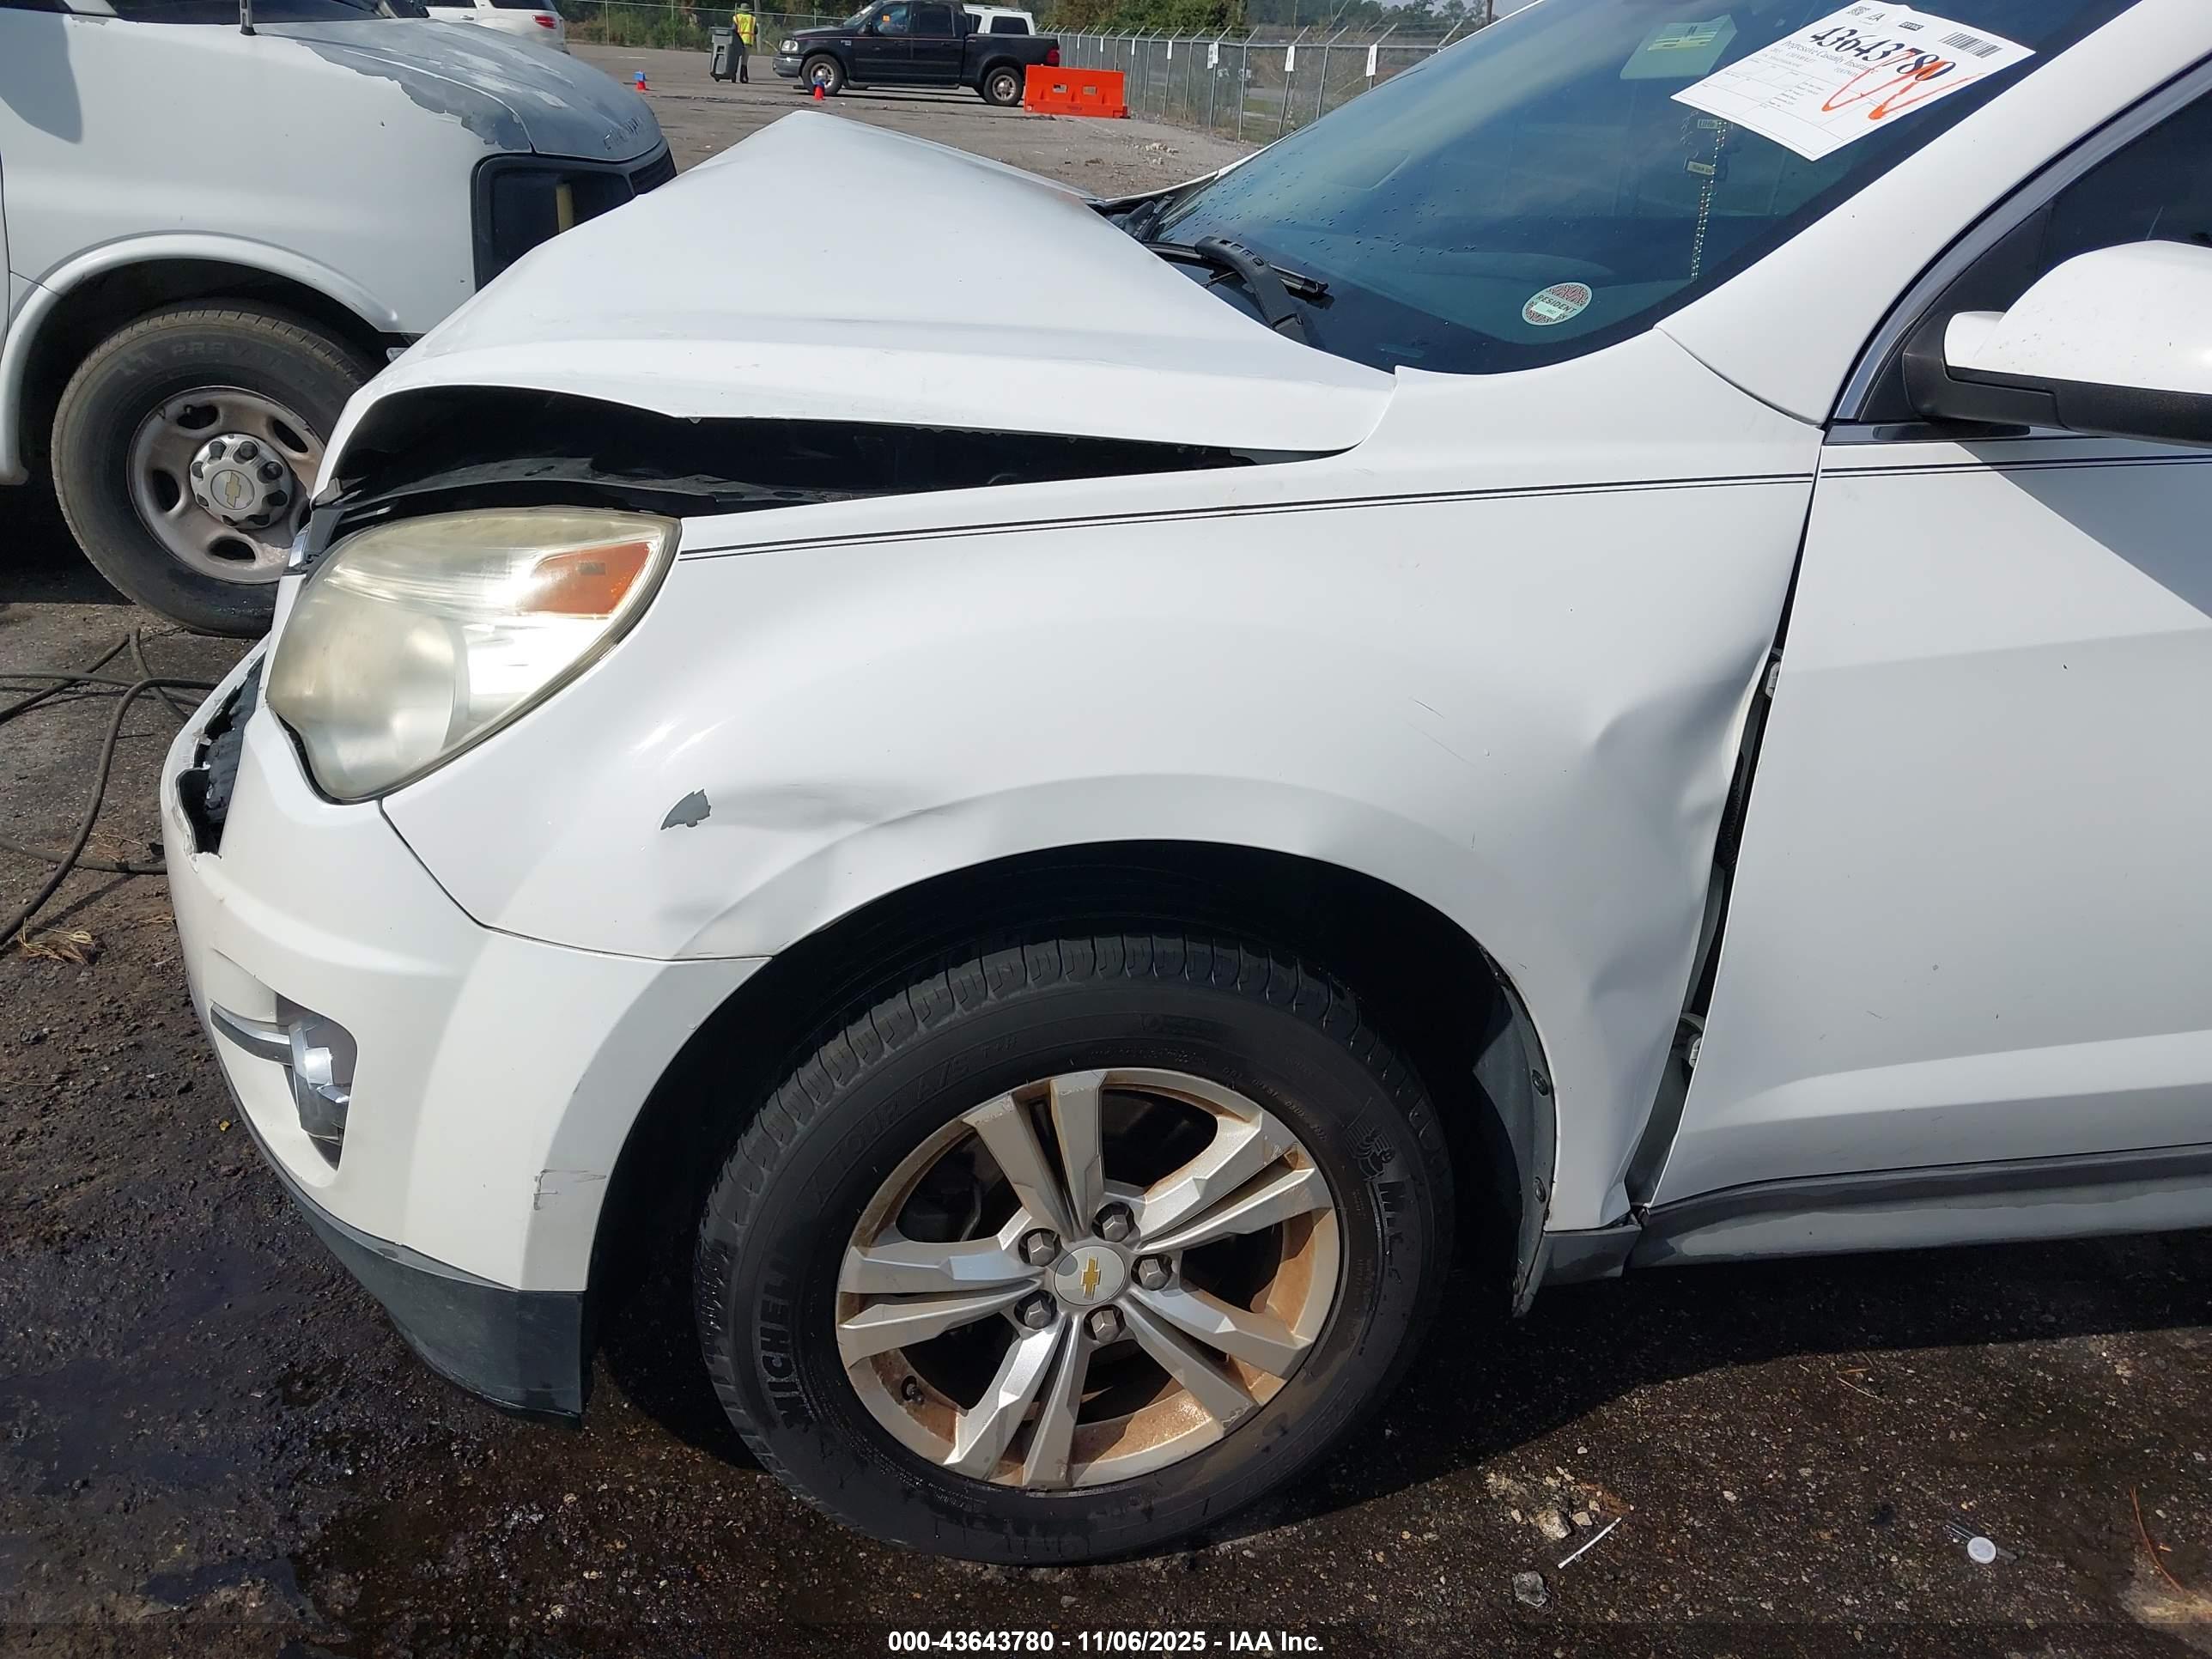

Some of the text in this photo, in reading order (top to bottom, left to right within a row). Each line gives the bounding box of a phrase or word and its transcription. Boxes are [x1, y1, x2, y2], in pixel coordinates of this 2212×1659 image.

[1806, 26, 1957, 82] 43643780
[1535, 295, 1577, 313] RESIDENT
[758, 1235, 813, 1431] MICHELI
